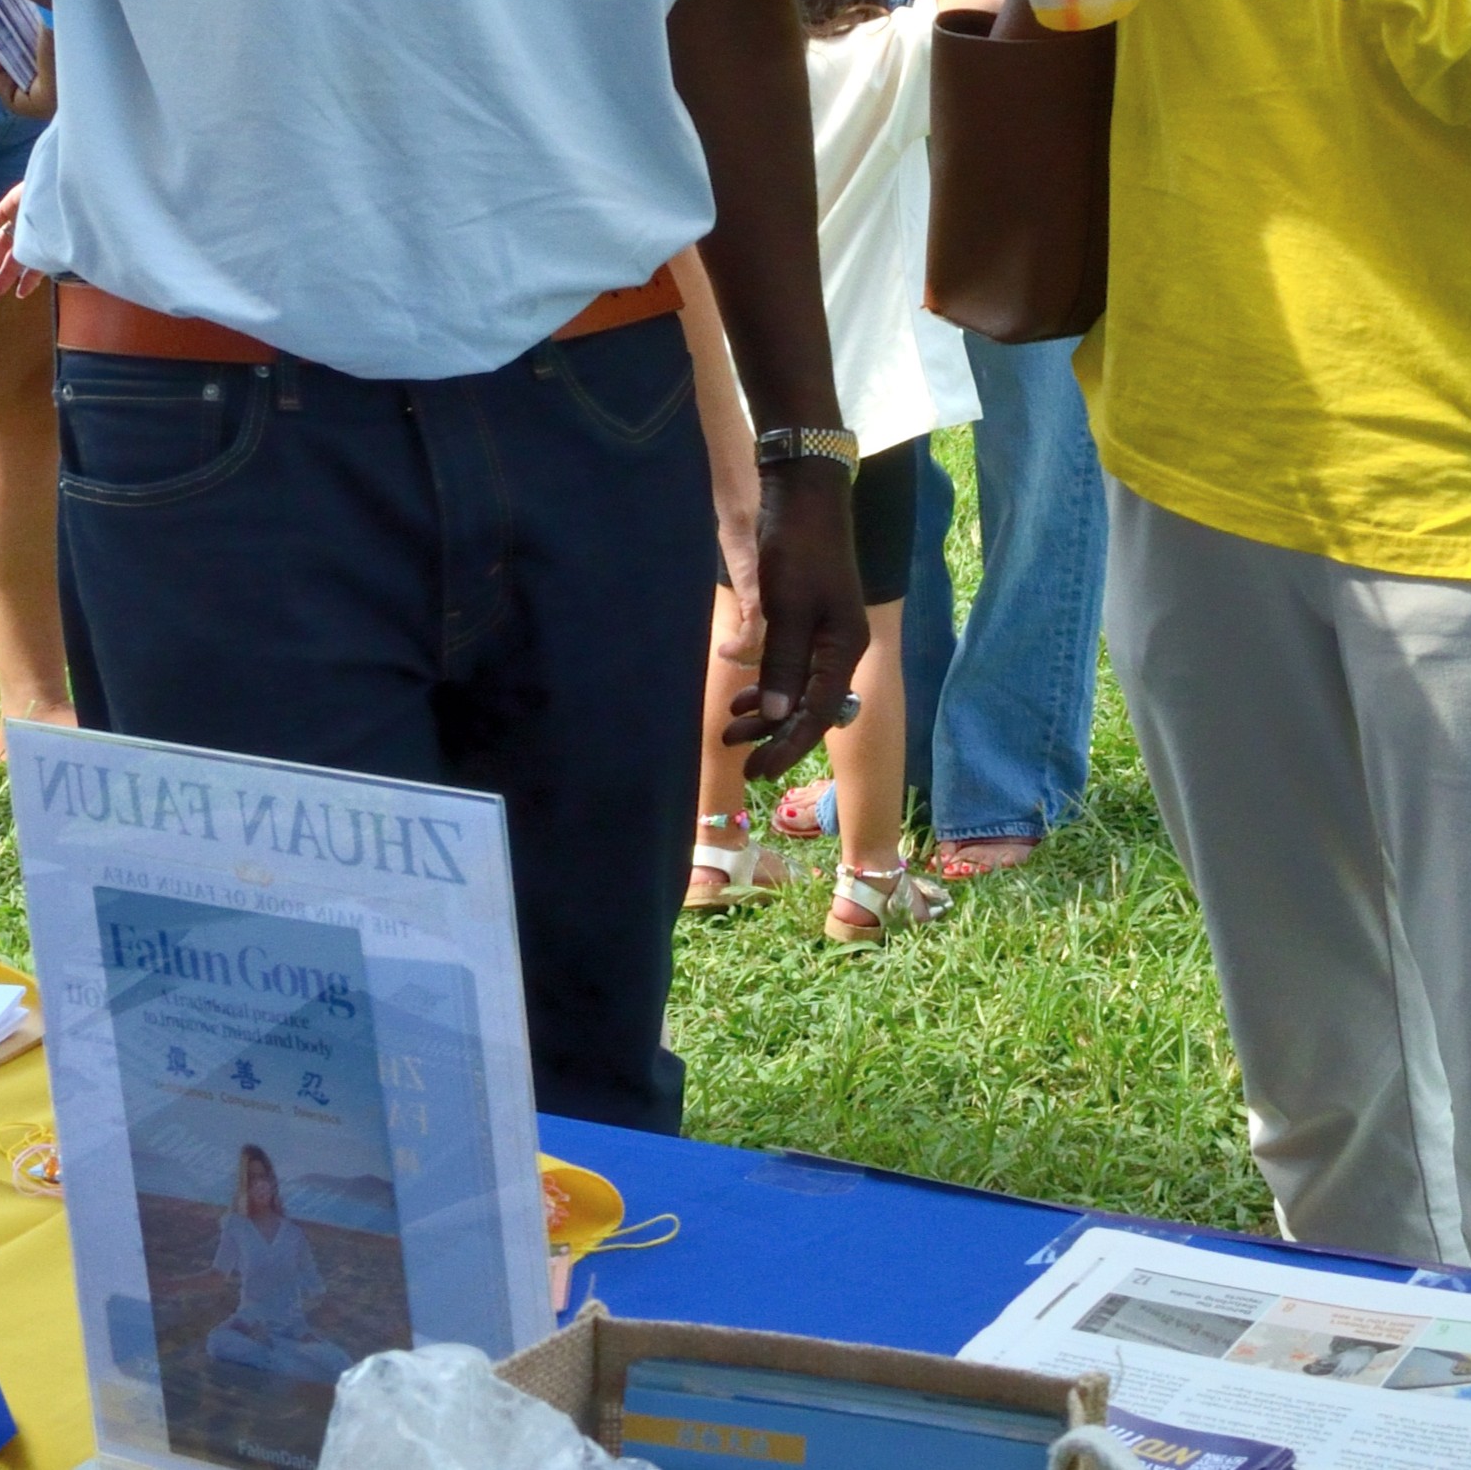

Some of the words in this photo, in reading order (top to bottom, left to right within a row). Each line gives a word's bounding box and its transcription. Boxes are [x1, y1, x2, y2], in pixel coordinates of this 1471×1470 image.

[108, 923, 232, 987] Falun
[237, 945, 356, 1019] Gong
[251, 1005, 310, 1030] practice
[261, 1031, 293, 1049] and
[295, 1036, 333, 1060] body
[1133, 1275, 1153, 1286] 12
[1130, 1438, 1201, 1466] NTD
